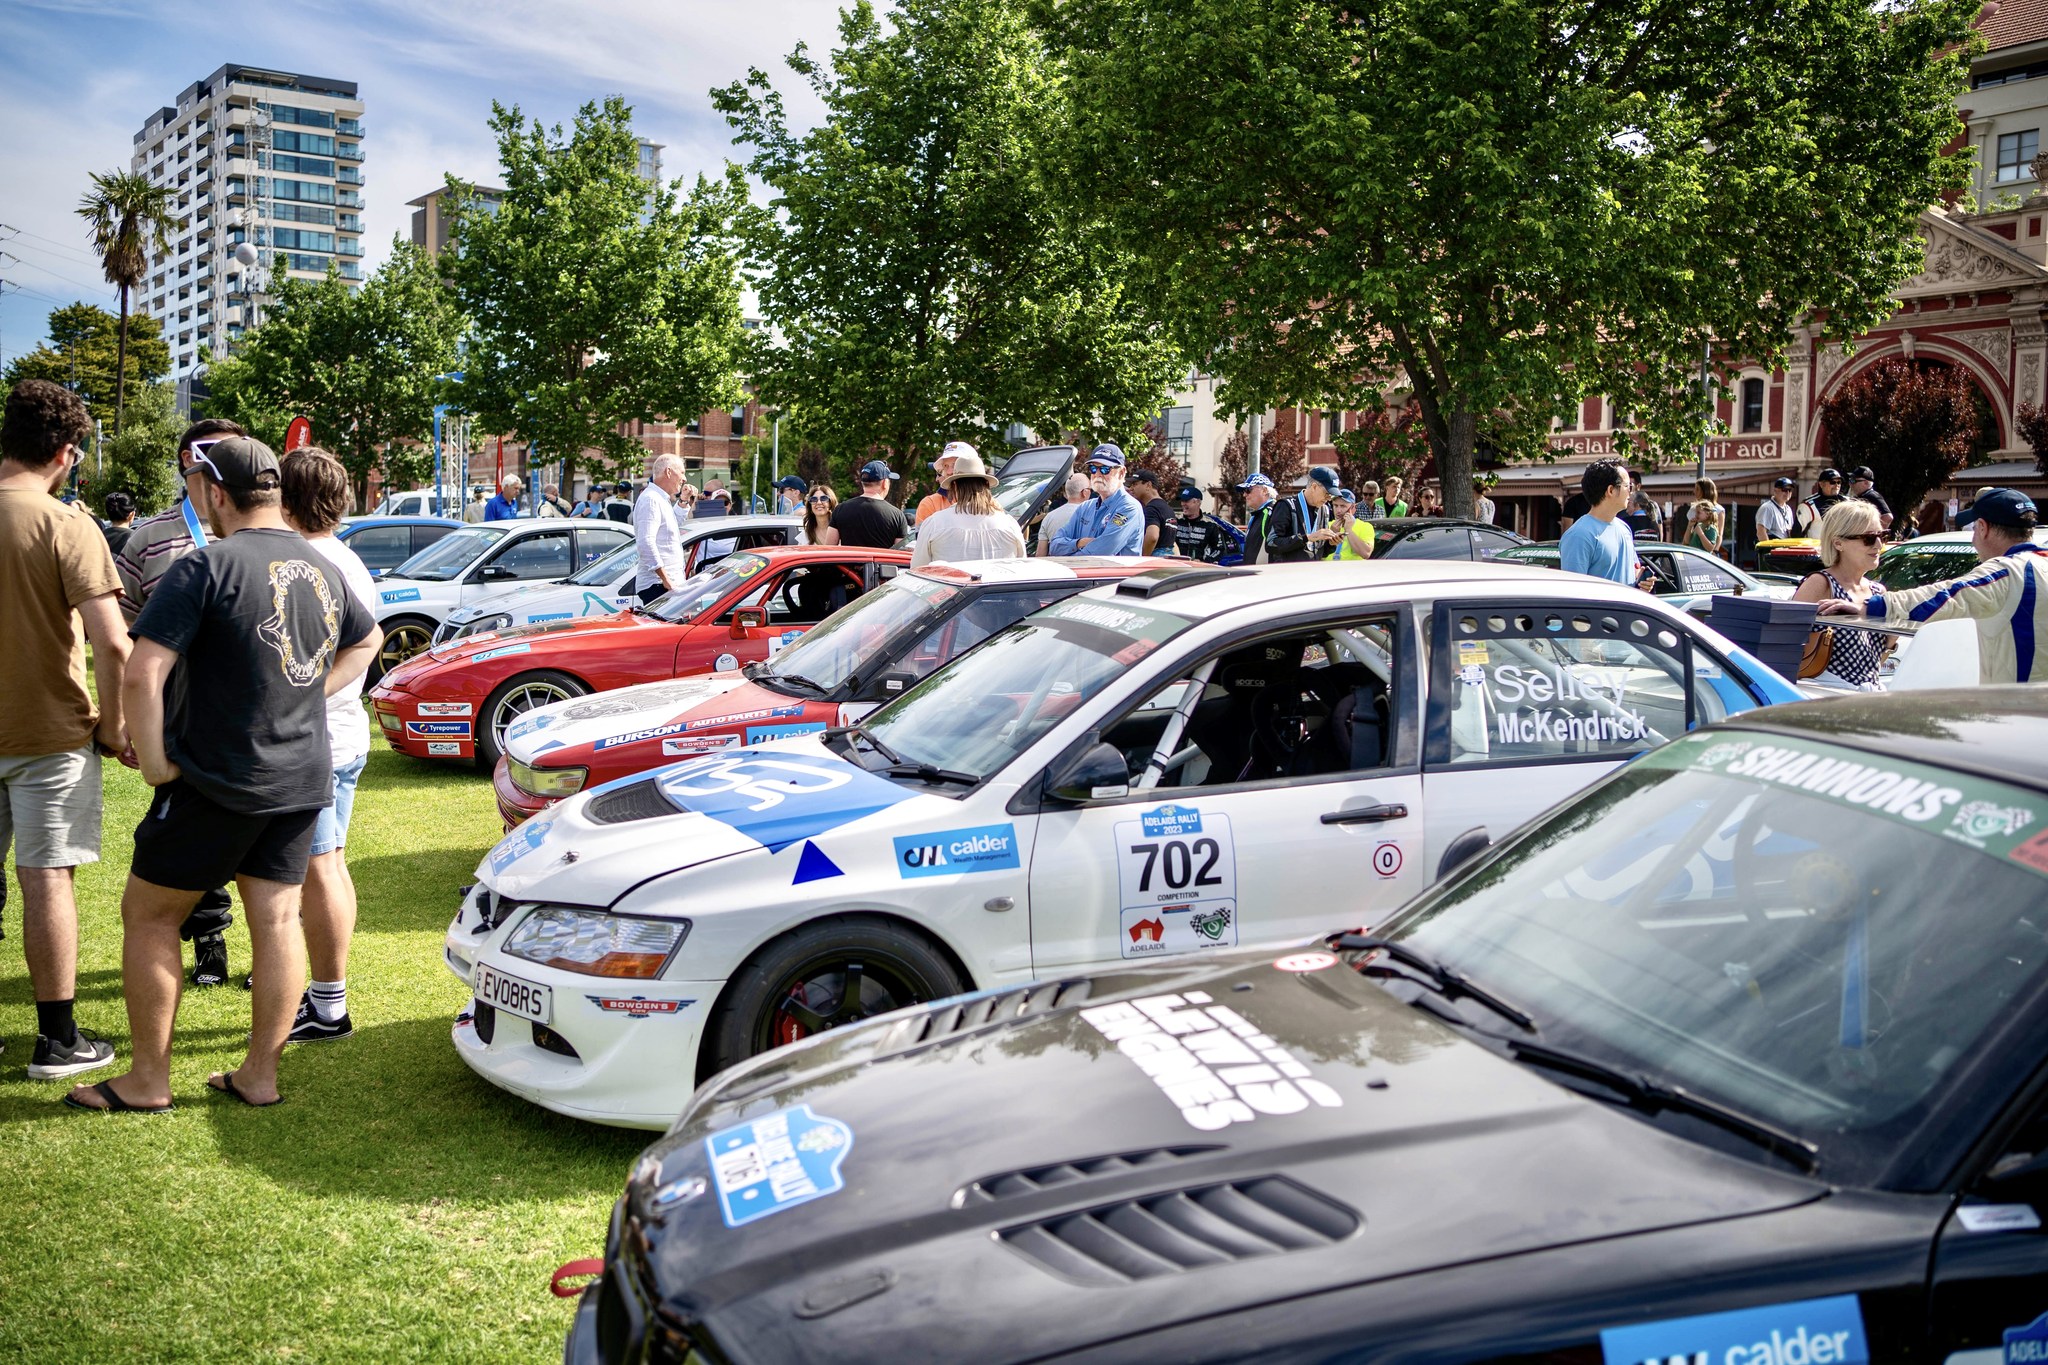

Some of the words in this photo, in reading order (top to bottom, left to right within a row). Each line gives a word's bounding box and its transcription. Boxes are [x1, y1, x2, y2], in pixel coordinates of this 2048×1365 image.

[1737, 438, 1778, 459] and
[1235, 678, 1266, 687] sparco
[1494, 664, 1629, 707] Selley
[604, 723, 682, 747] BURSON
[692, 715, 727, 728] AUTO
[727, 709, 769, 723] PARTS
[1499, 709, 1649, 744] McKendrick
[1725, 745, 1964, 822] SHANNONS
[1144, 814, 1177, 827] ADELAIDE
[1177, 812, 1198, 824] RALLY
[1162, 825, 1183, 835] 2023
[950, 834, 1009, 856] calder
[973, 852, 1011, 862] Management
[1131, 838, 1222, 892] 702
[1157, 891, 1199, 901] COMPETITION
[1129, 942, 1166, 953] ADELAIDE
[609, 1000, 669, 1010] BOWDEN'S
[1724, 1326, 1849, 1365] calder
